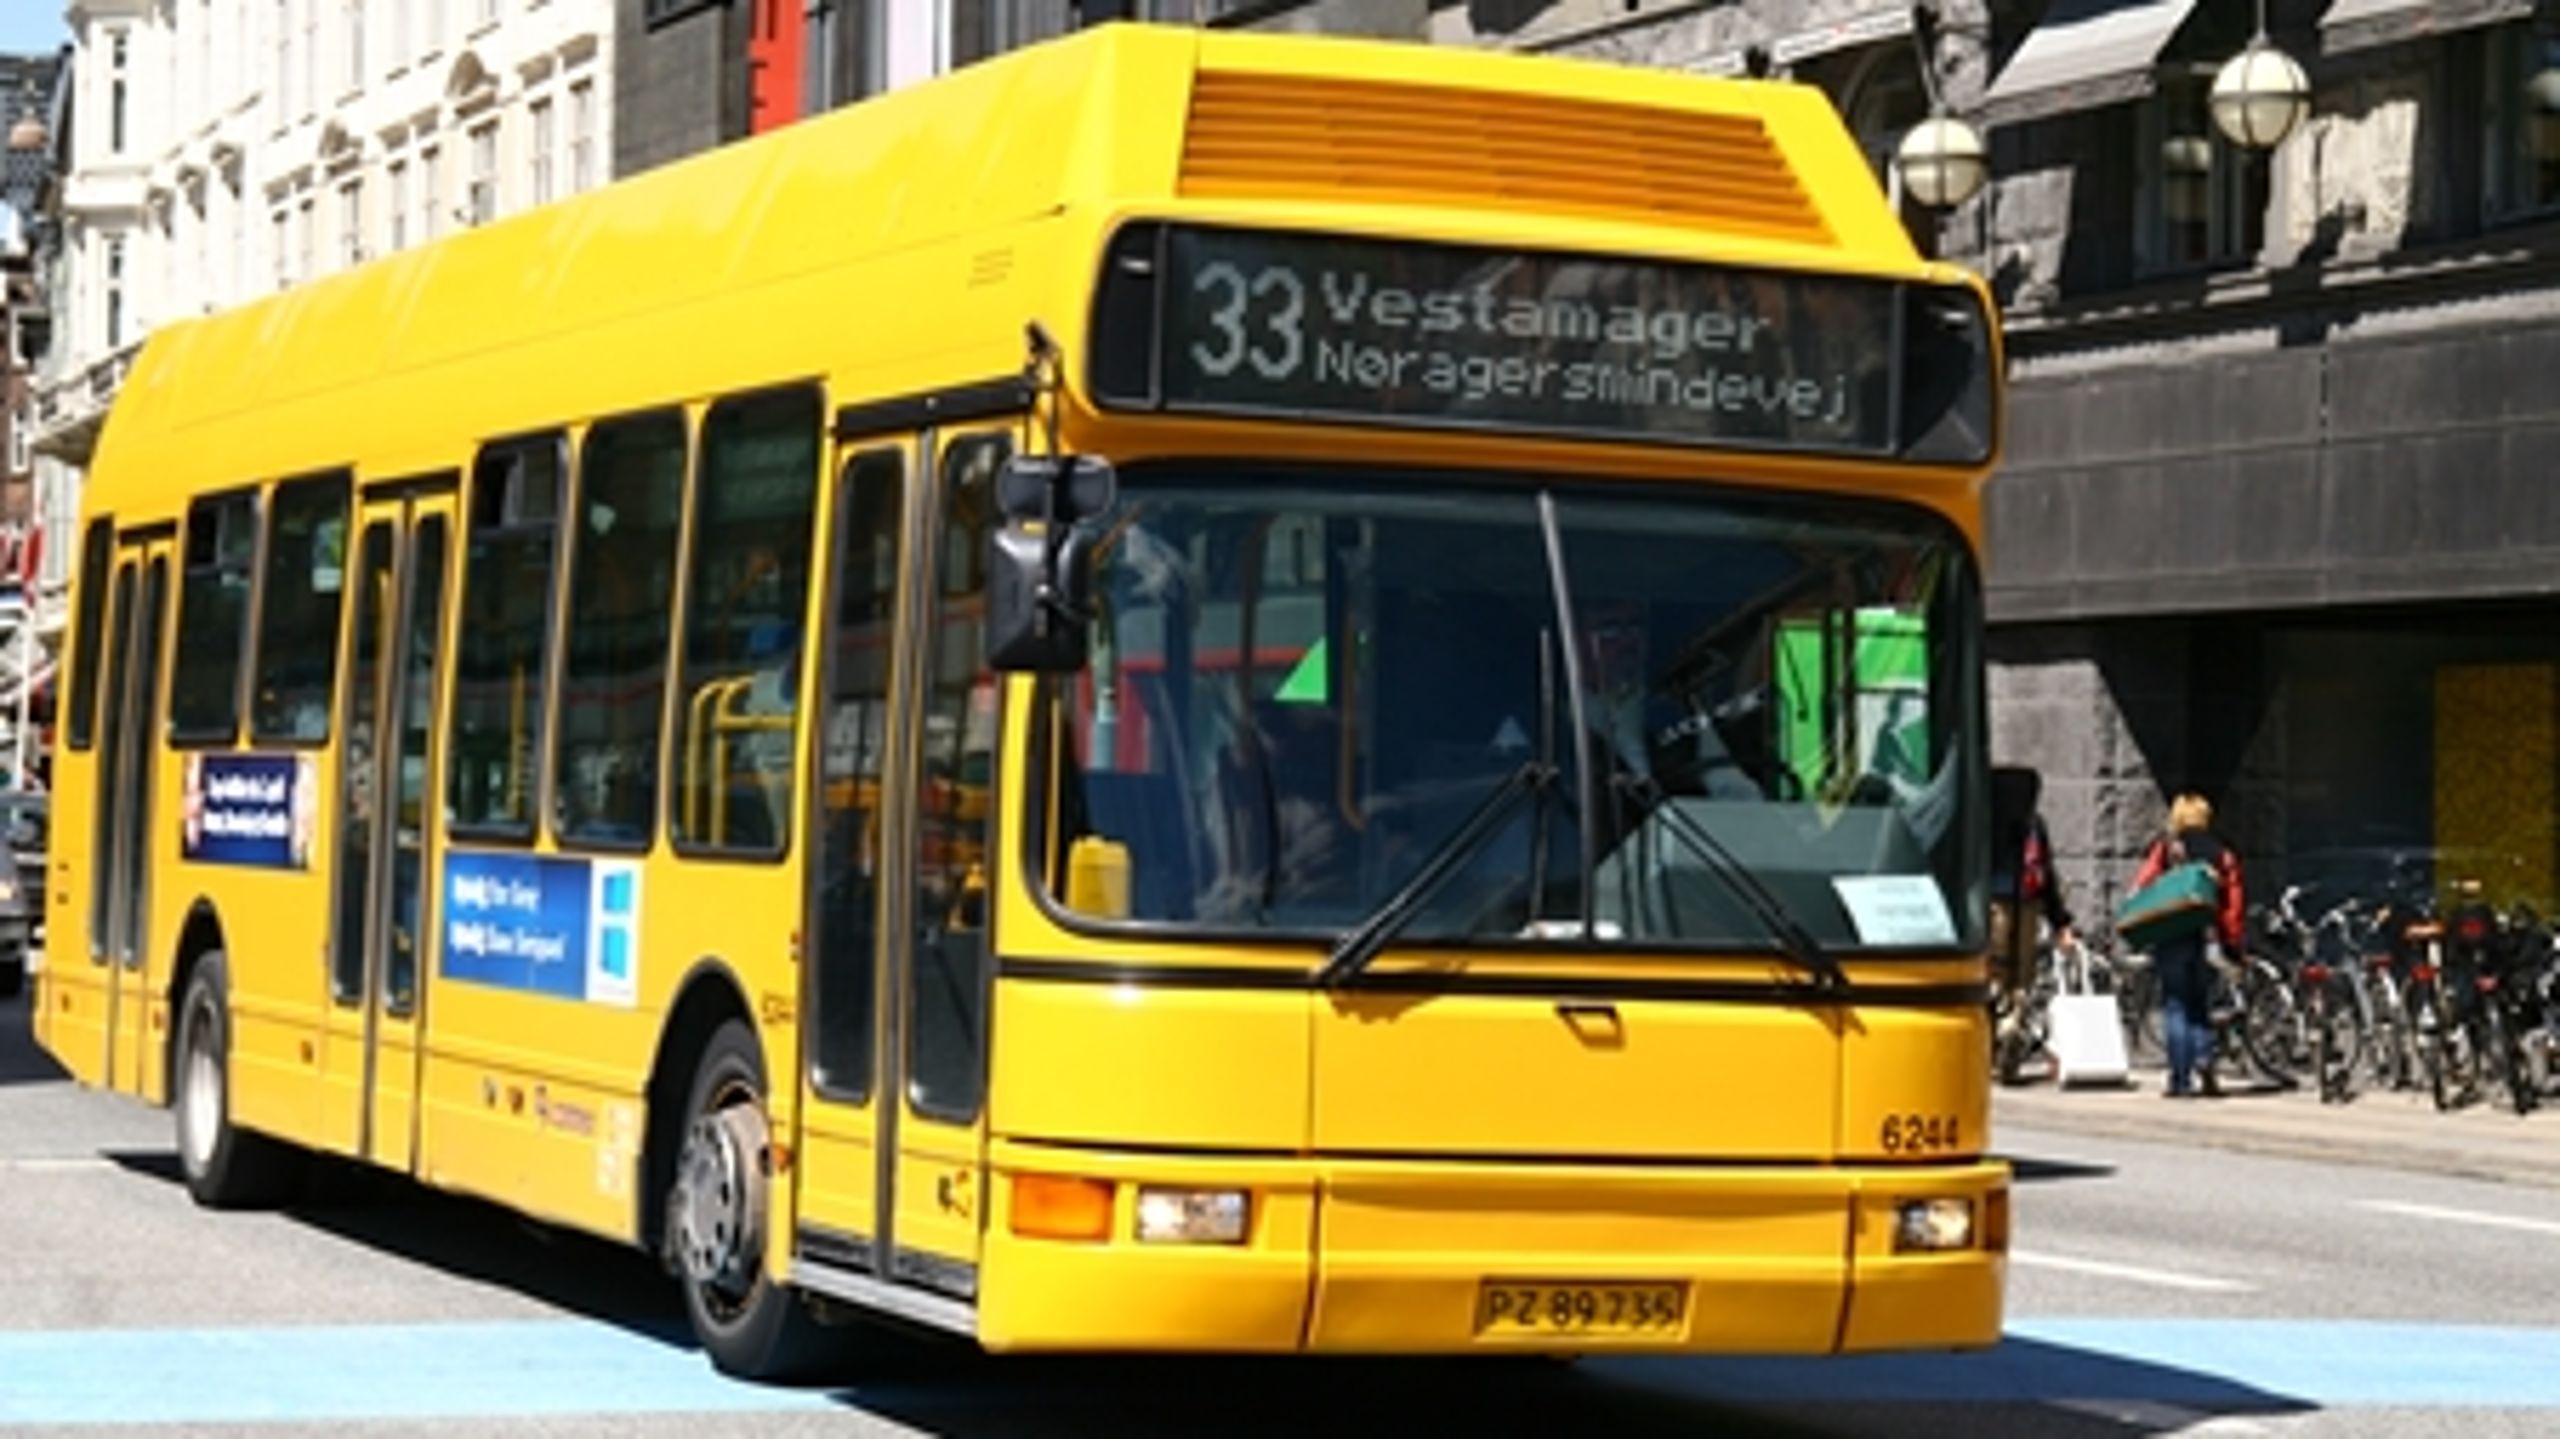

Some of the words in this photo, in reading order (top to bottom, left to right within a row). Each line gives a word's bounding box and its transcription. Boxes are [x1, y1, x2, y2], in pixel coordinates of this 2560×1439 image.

[1193, 262, 1303, 377] 33
[1321, 271, 1770, 358] Vestamager
[1882, 1113, 1958, 1151] 6244
[1488, 1288, 1538, 1326] PZ
